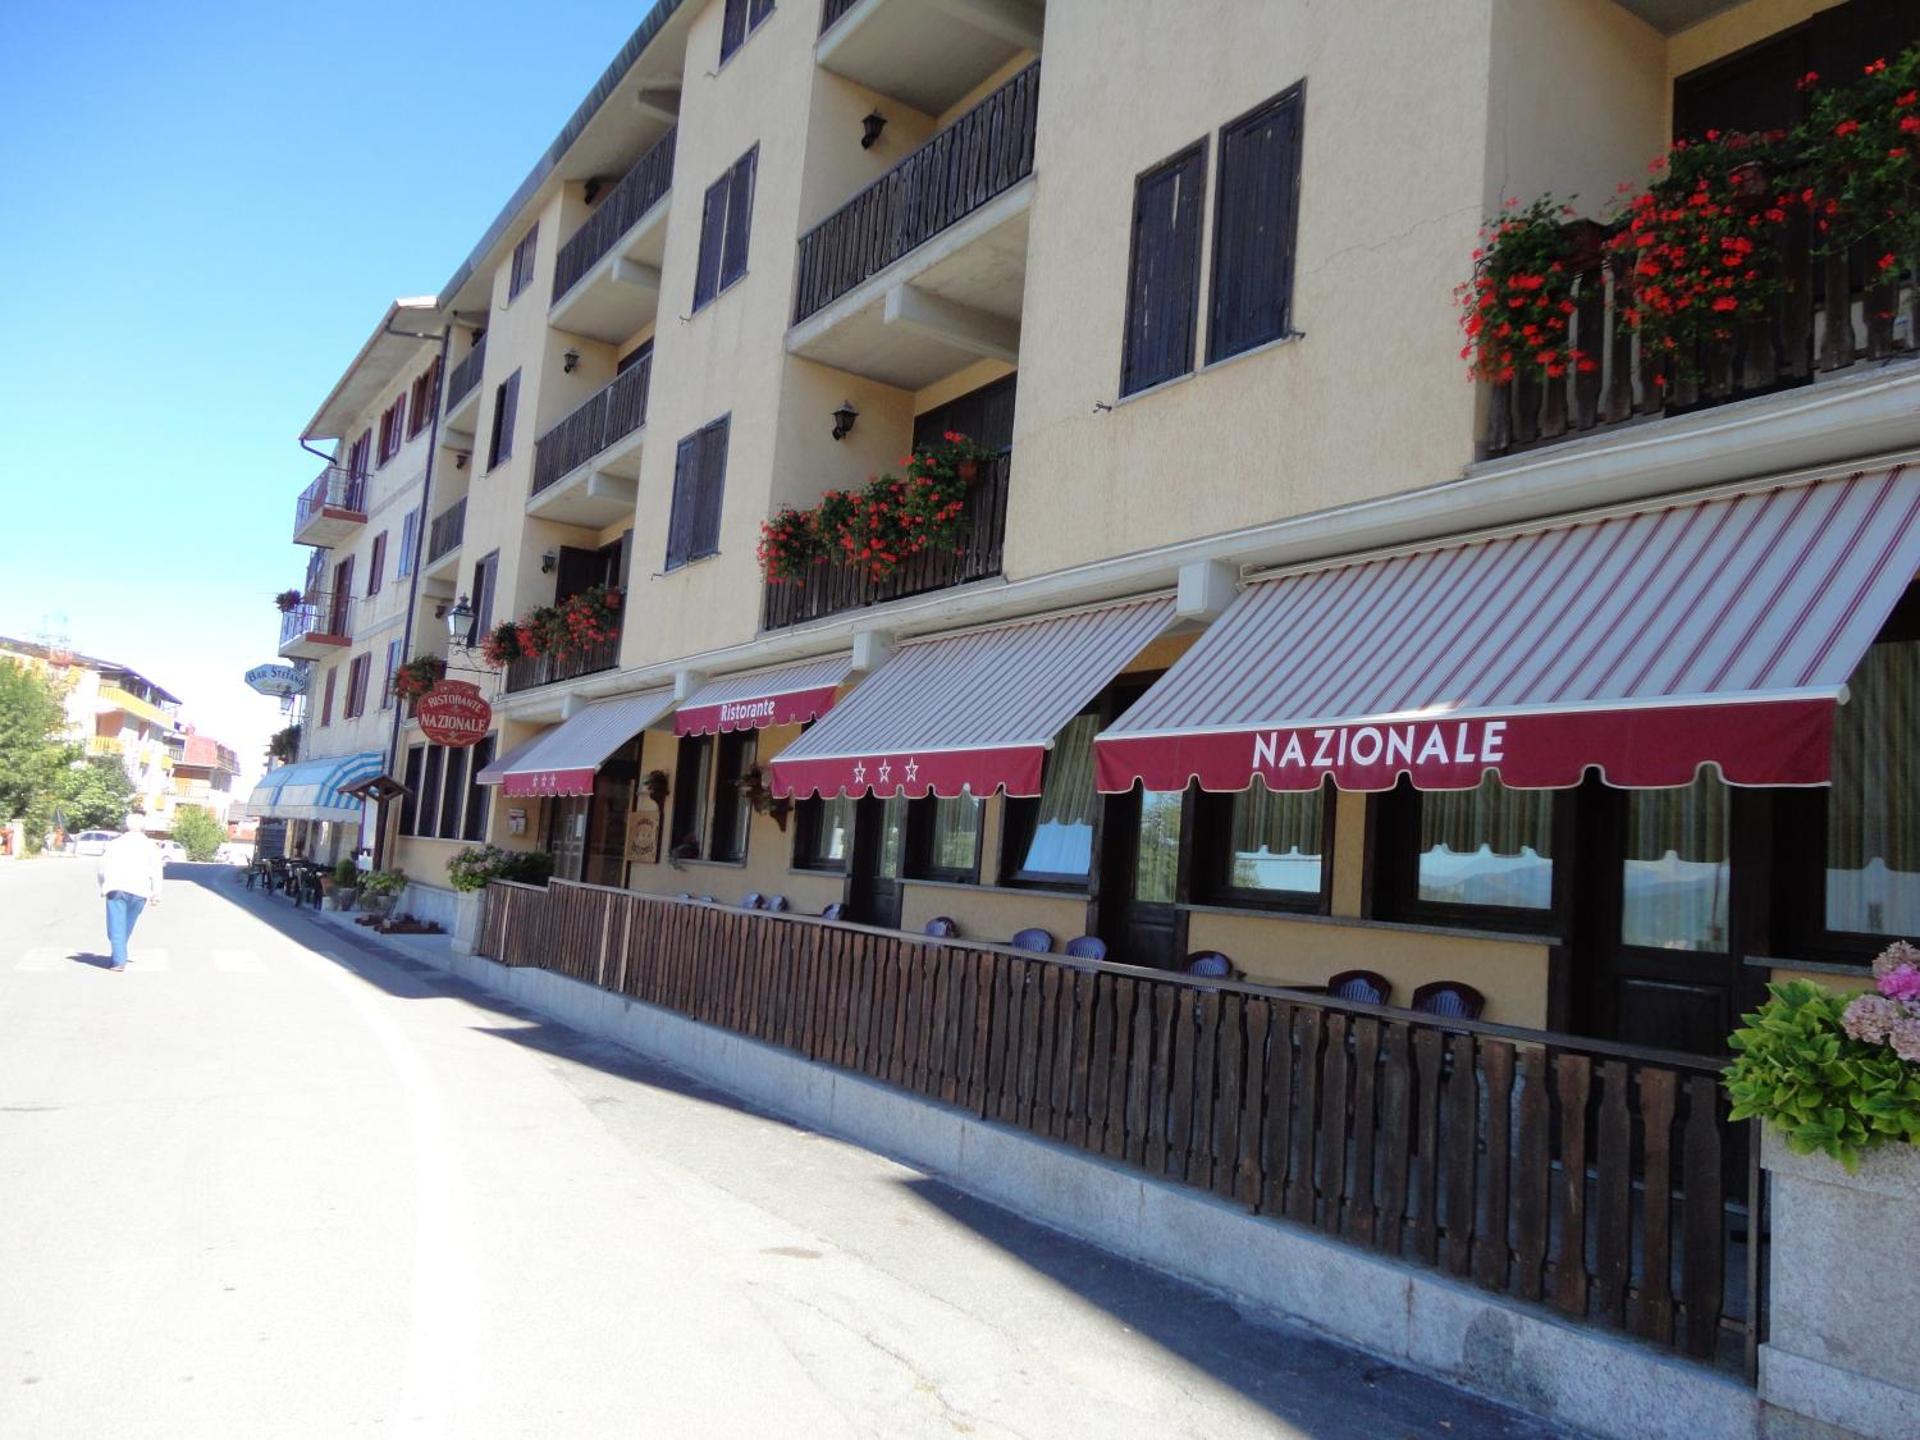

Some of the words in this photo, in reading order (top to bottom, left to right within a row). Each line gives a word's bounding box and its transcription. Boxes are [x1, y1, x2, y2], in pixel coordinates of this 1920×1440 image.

[428, 694, 482, 712] RISTORANTE
[721, 699, 776, 722] Ristorante
[420, 713, 486, 732] NAZIONALE
[1252, 721, 1507, 769] NAZIONALE
